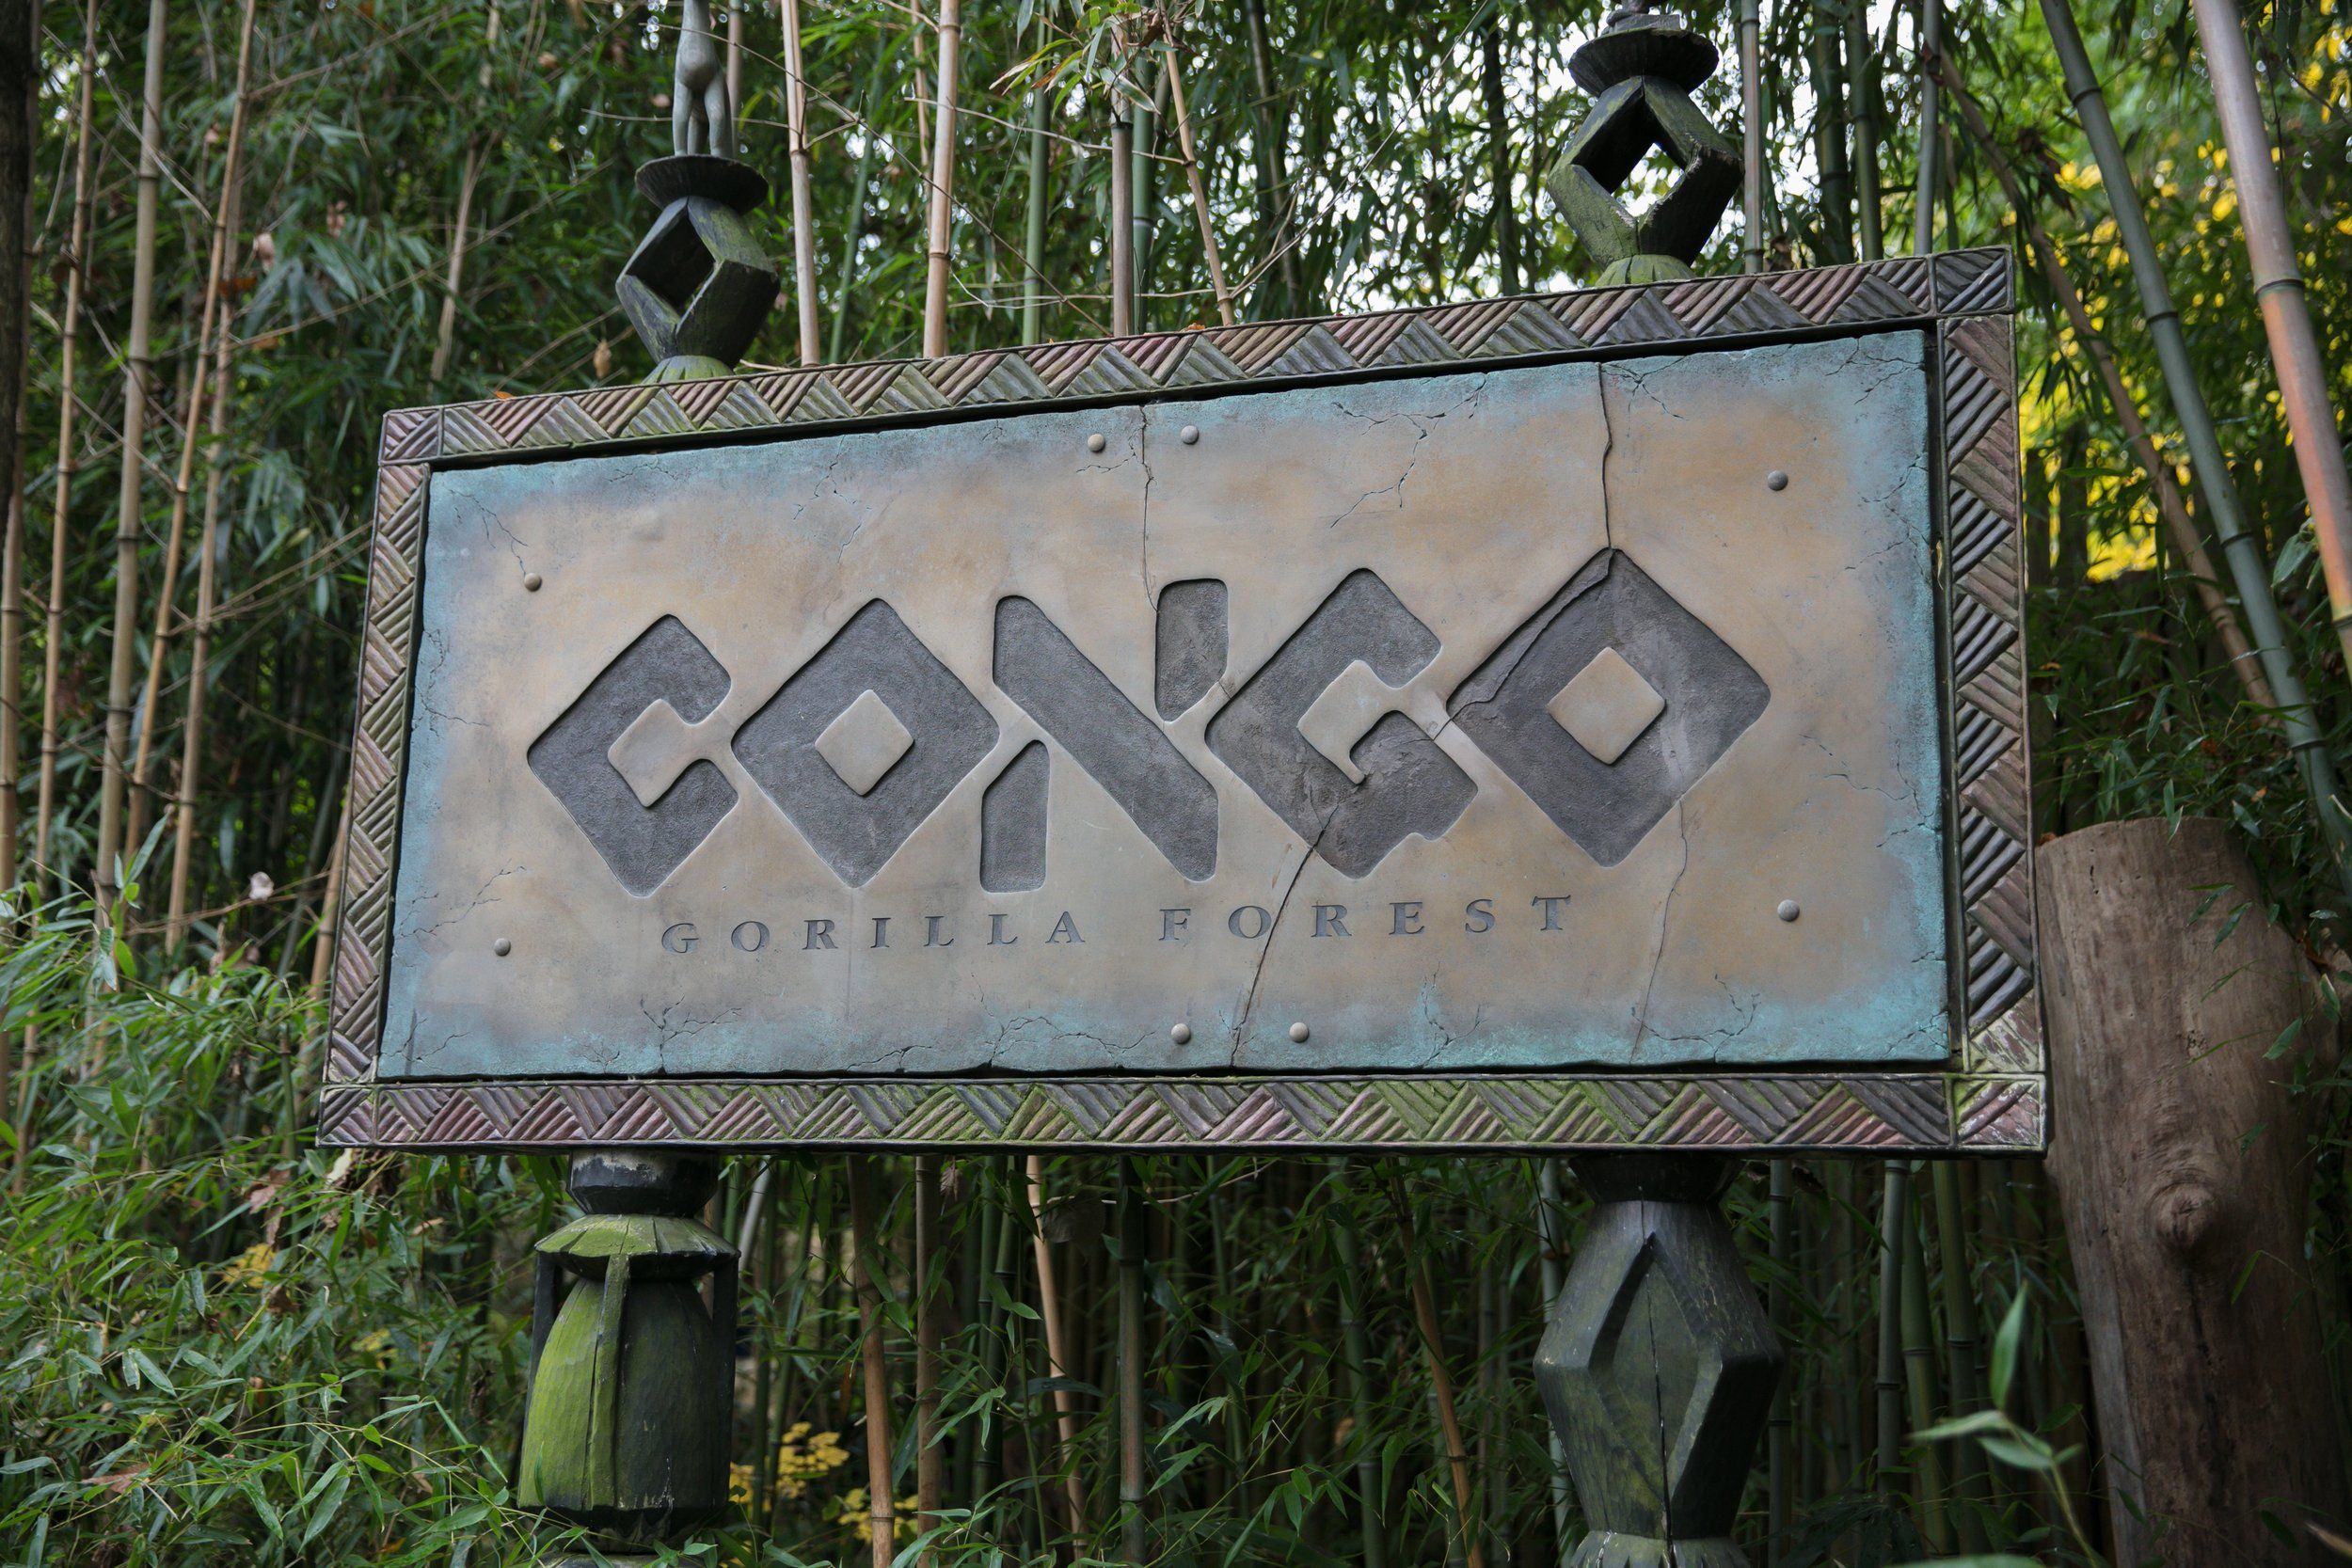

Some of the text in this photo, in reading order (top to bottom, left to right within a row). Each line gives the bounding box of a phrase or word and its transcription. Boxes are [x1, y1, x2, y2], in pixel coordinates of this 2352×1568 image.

[527, 547, 1771, 896] CONGO
[661, 895, 1570, 954] GORILLA FOREST
